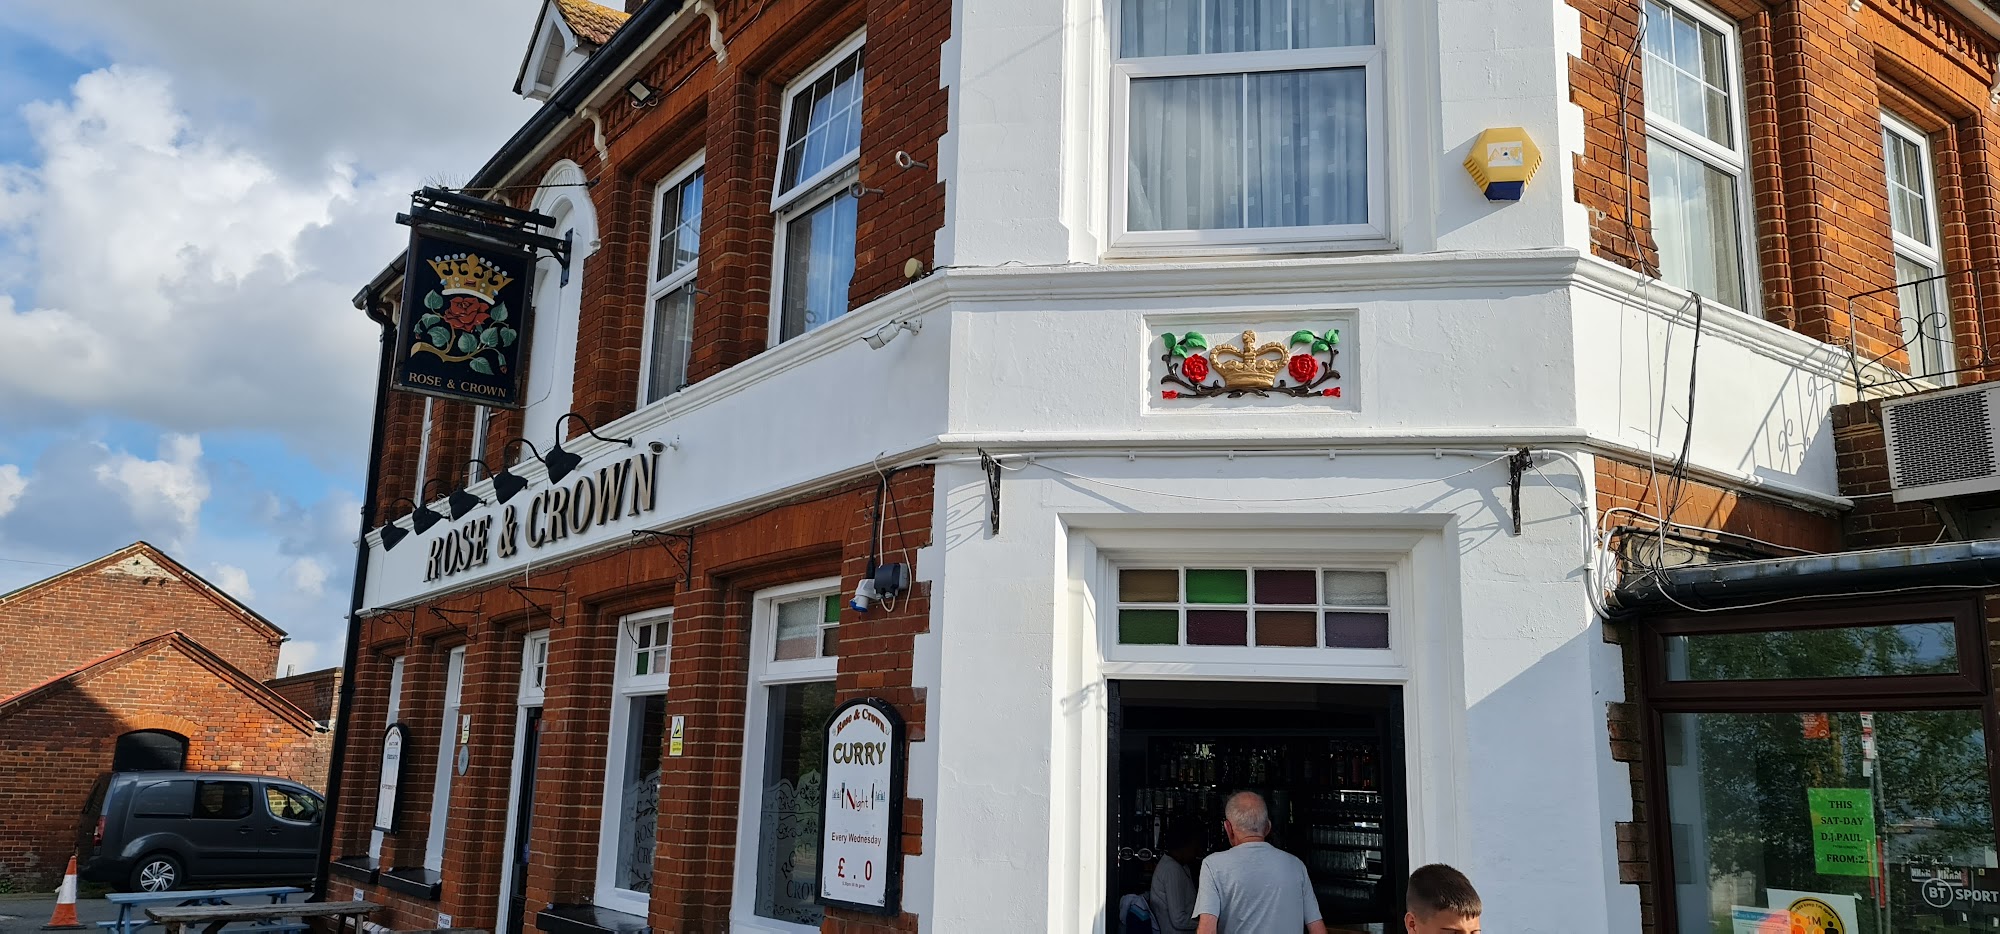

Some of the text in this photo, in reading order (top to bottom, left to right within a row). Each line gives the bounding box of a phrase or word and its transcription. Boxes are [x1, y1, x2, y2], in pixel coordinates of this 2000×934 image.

[408, 372, 507, 398] ROSE & CROWN
[423, 453, 660, 582] ROSE & CROWN
[836, 708, 885, 736] Rose & Crown
[833, 741, 887, 766] CURRY
[1829, 800, 1853, 809] THIS
[1820, 816, 1864, 826] SAT-DAY
[831, 831, 881, 846] Every Wednesday
[837, 857, 846, 879] £
[786, 879, 816, 901] CRO
[1928, 886, 1999, 903] BT SPORT
[1806, 915, 1822, 926] 1M
